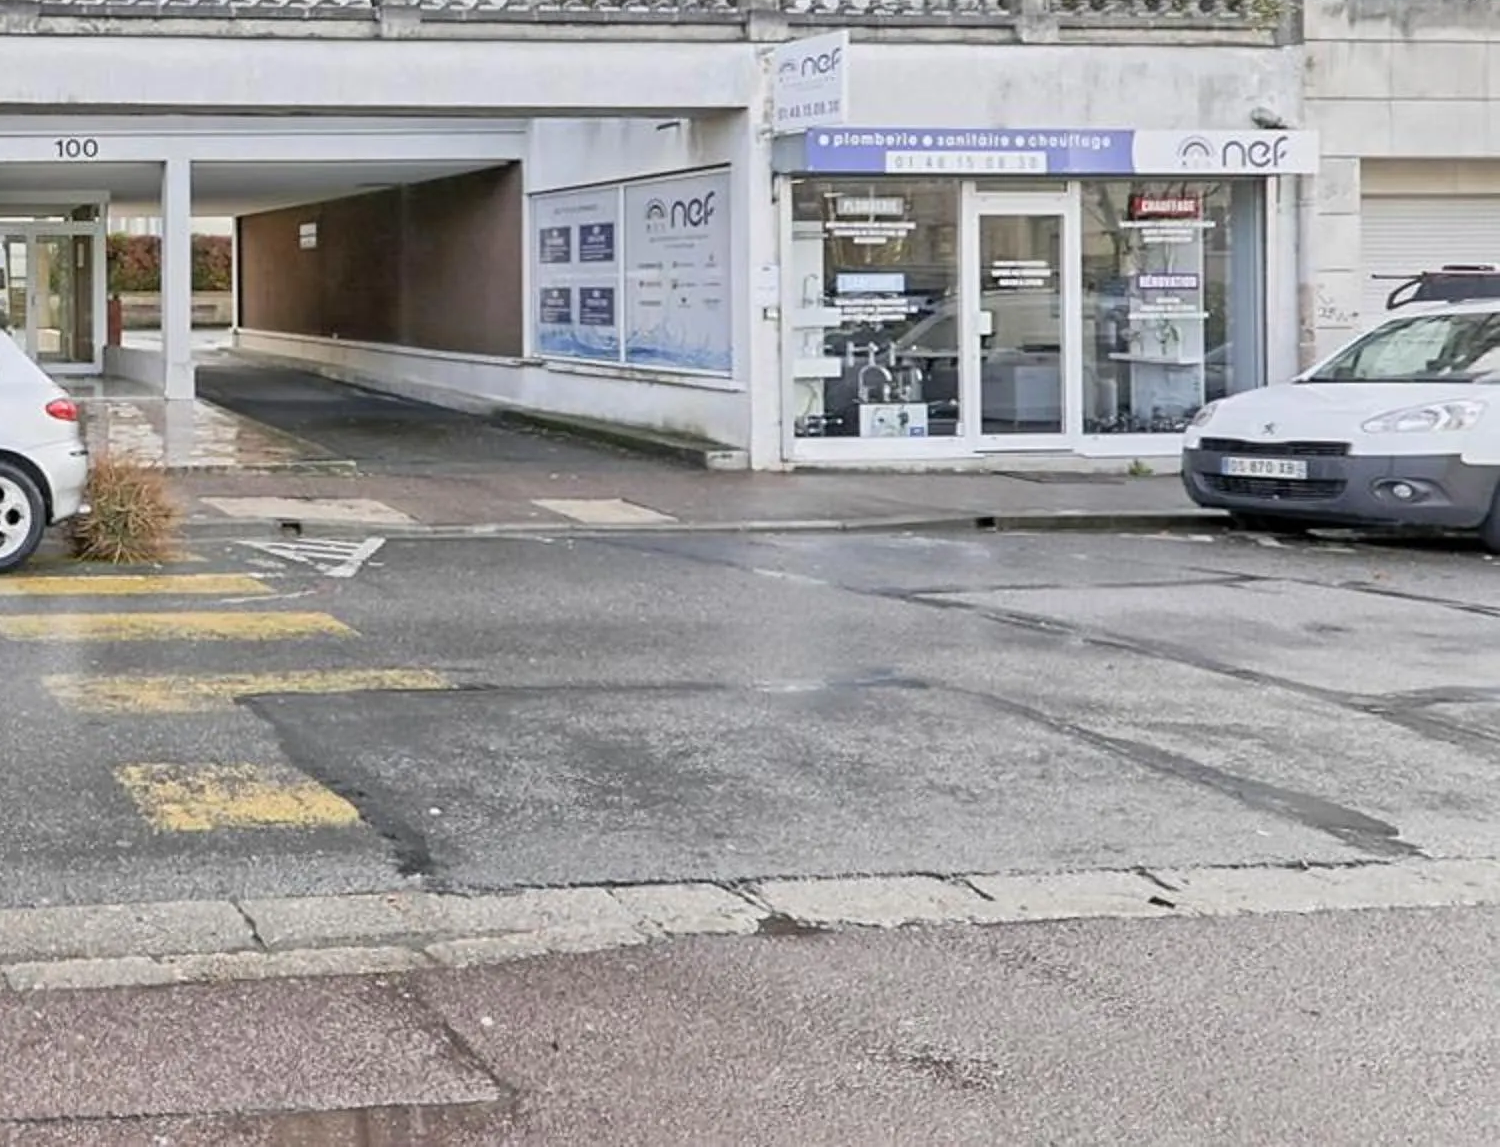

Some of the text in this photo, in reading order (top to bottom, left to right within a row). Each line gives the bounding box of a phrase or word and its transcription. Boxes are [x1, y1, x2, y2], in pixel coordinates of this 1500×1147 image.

[801, 46, 842, 78] nef
[54, 138, 99, 158] 100
[833, 129, 1112, 150] plomberie sanitaire chauffage
[1222, 135, 1289, 168] nef
[670, 190, 716, 229] nef
